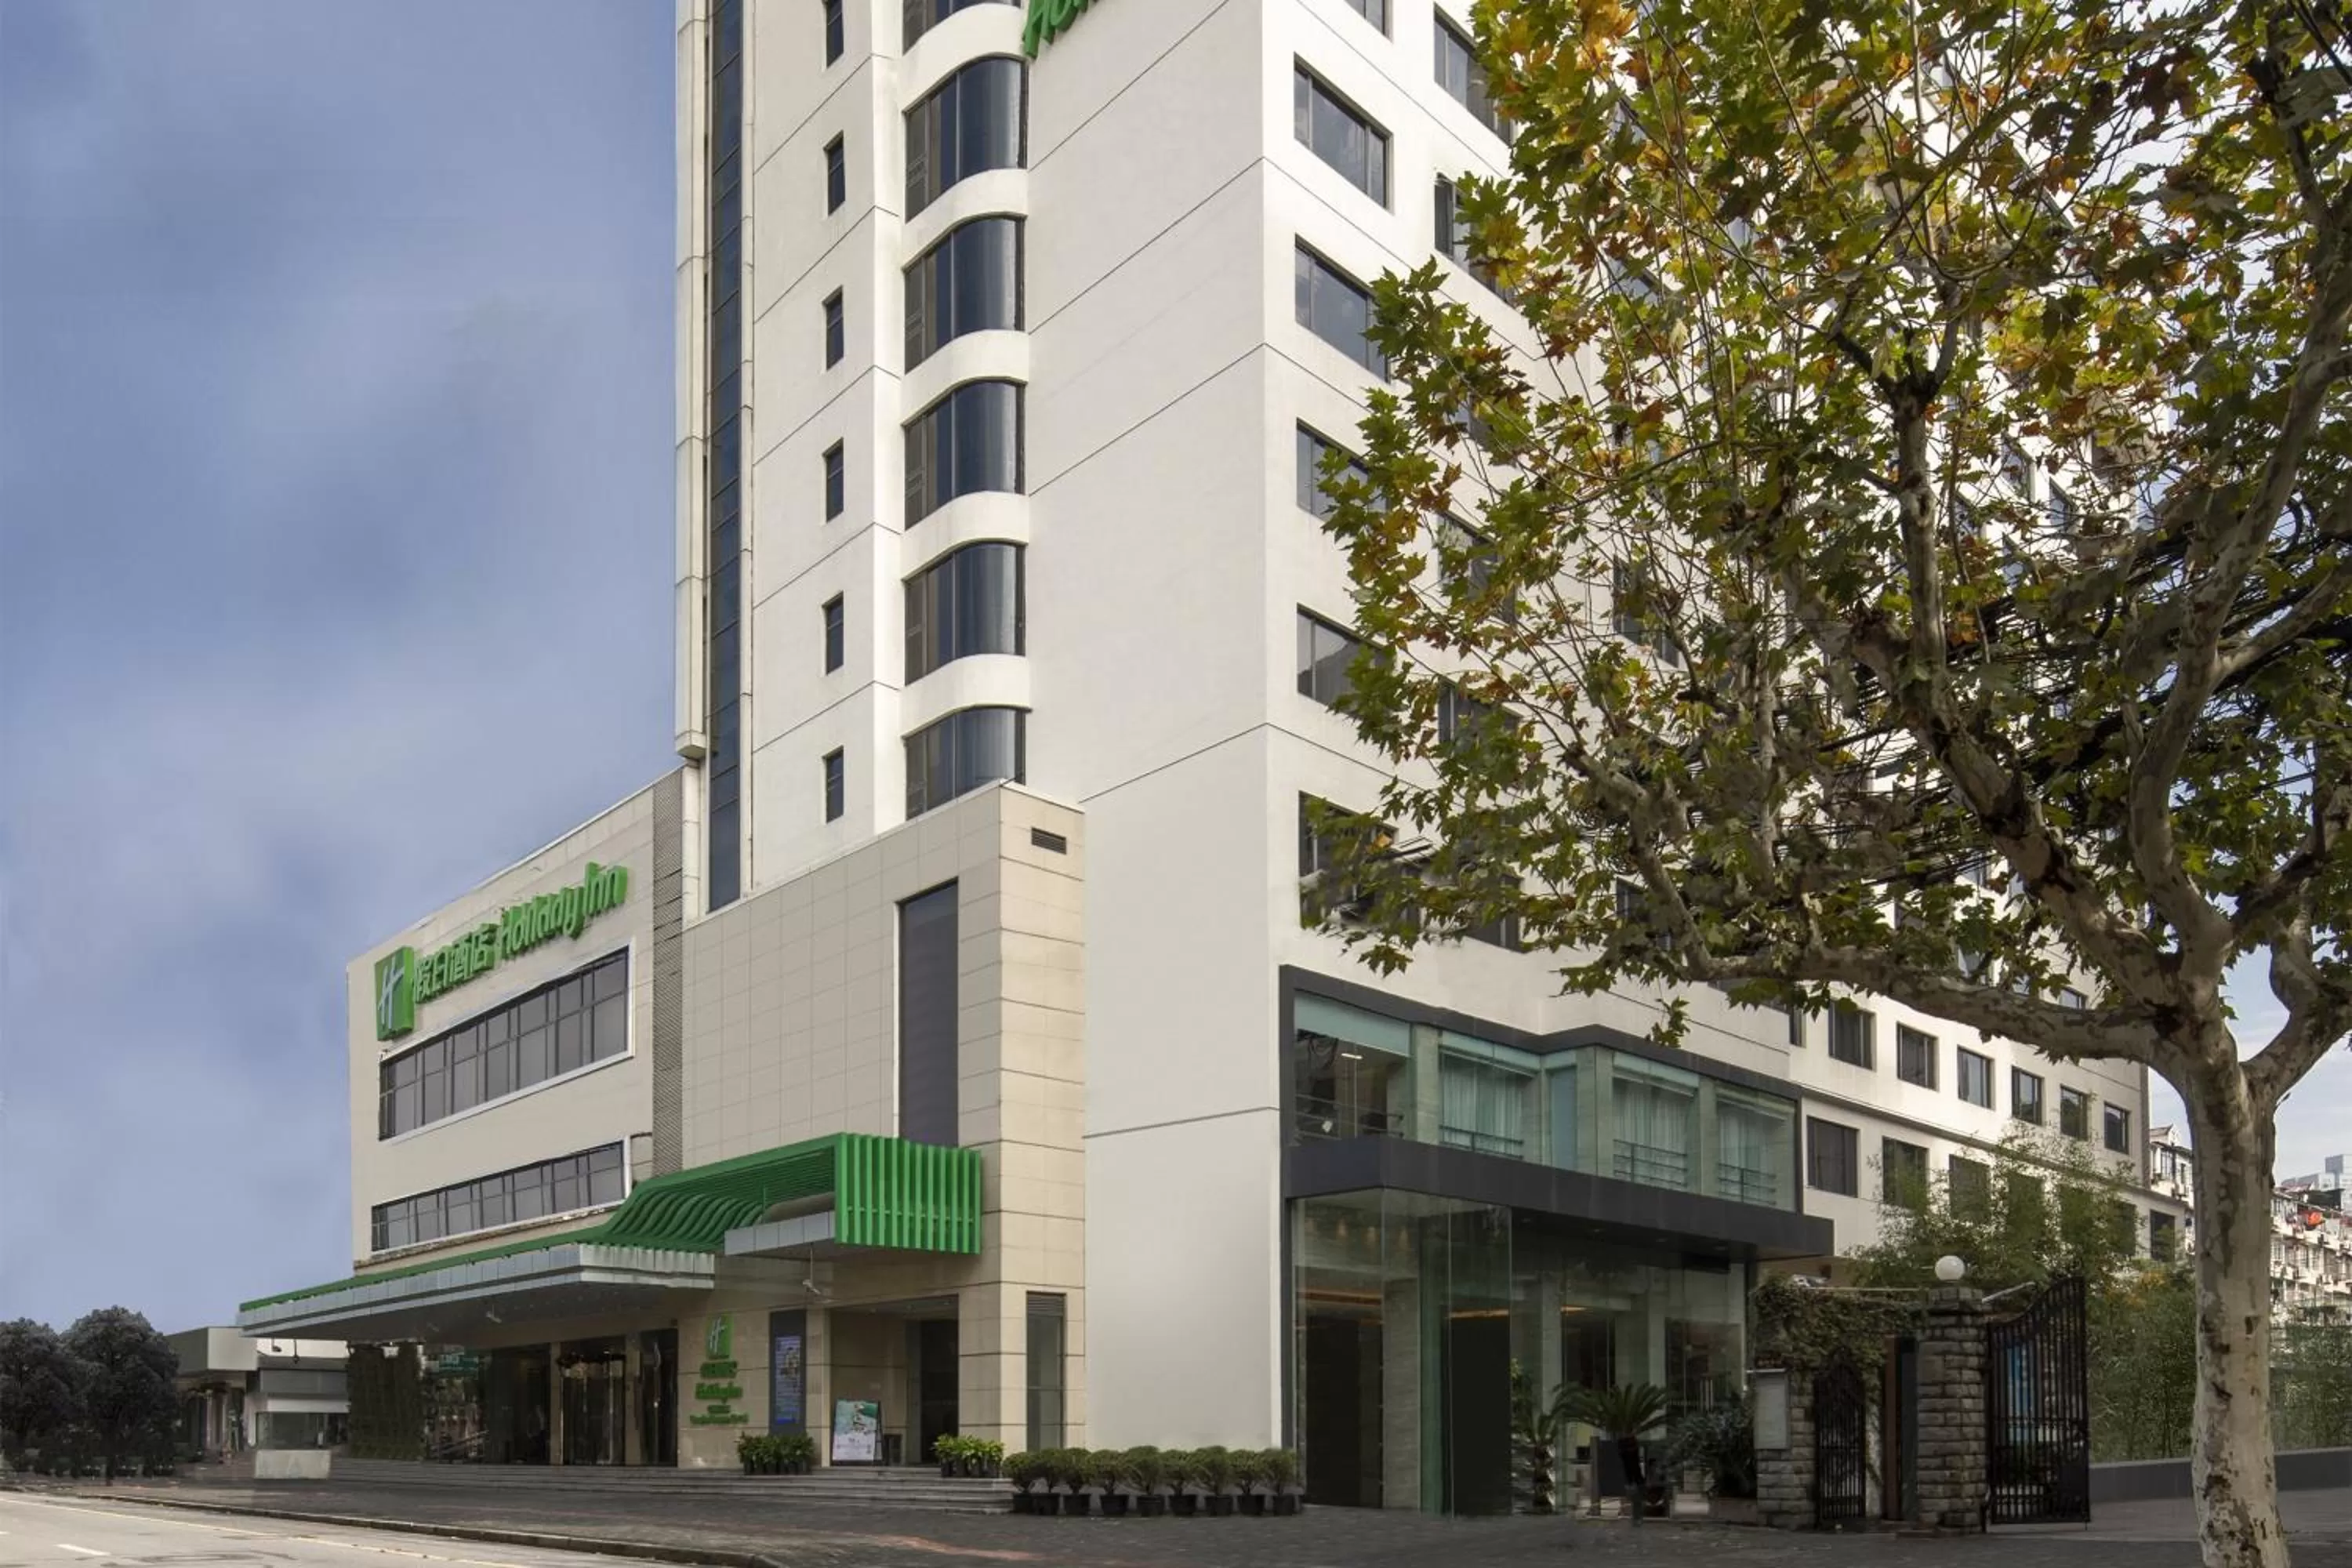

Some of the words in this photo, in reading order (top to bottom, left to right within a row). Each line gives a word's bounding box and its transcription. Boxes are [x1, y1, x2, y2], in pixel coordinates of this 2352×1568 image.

[495, 887, 584, 962] Holiday
[583, 862, 628, 916] Inn
[413, 923, 499, 1004] 假日酒店
